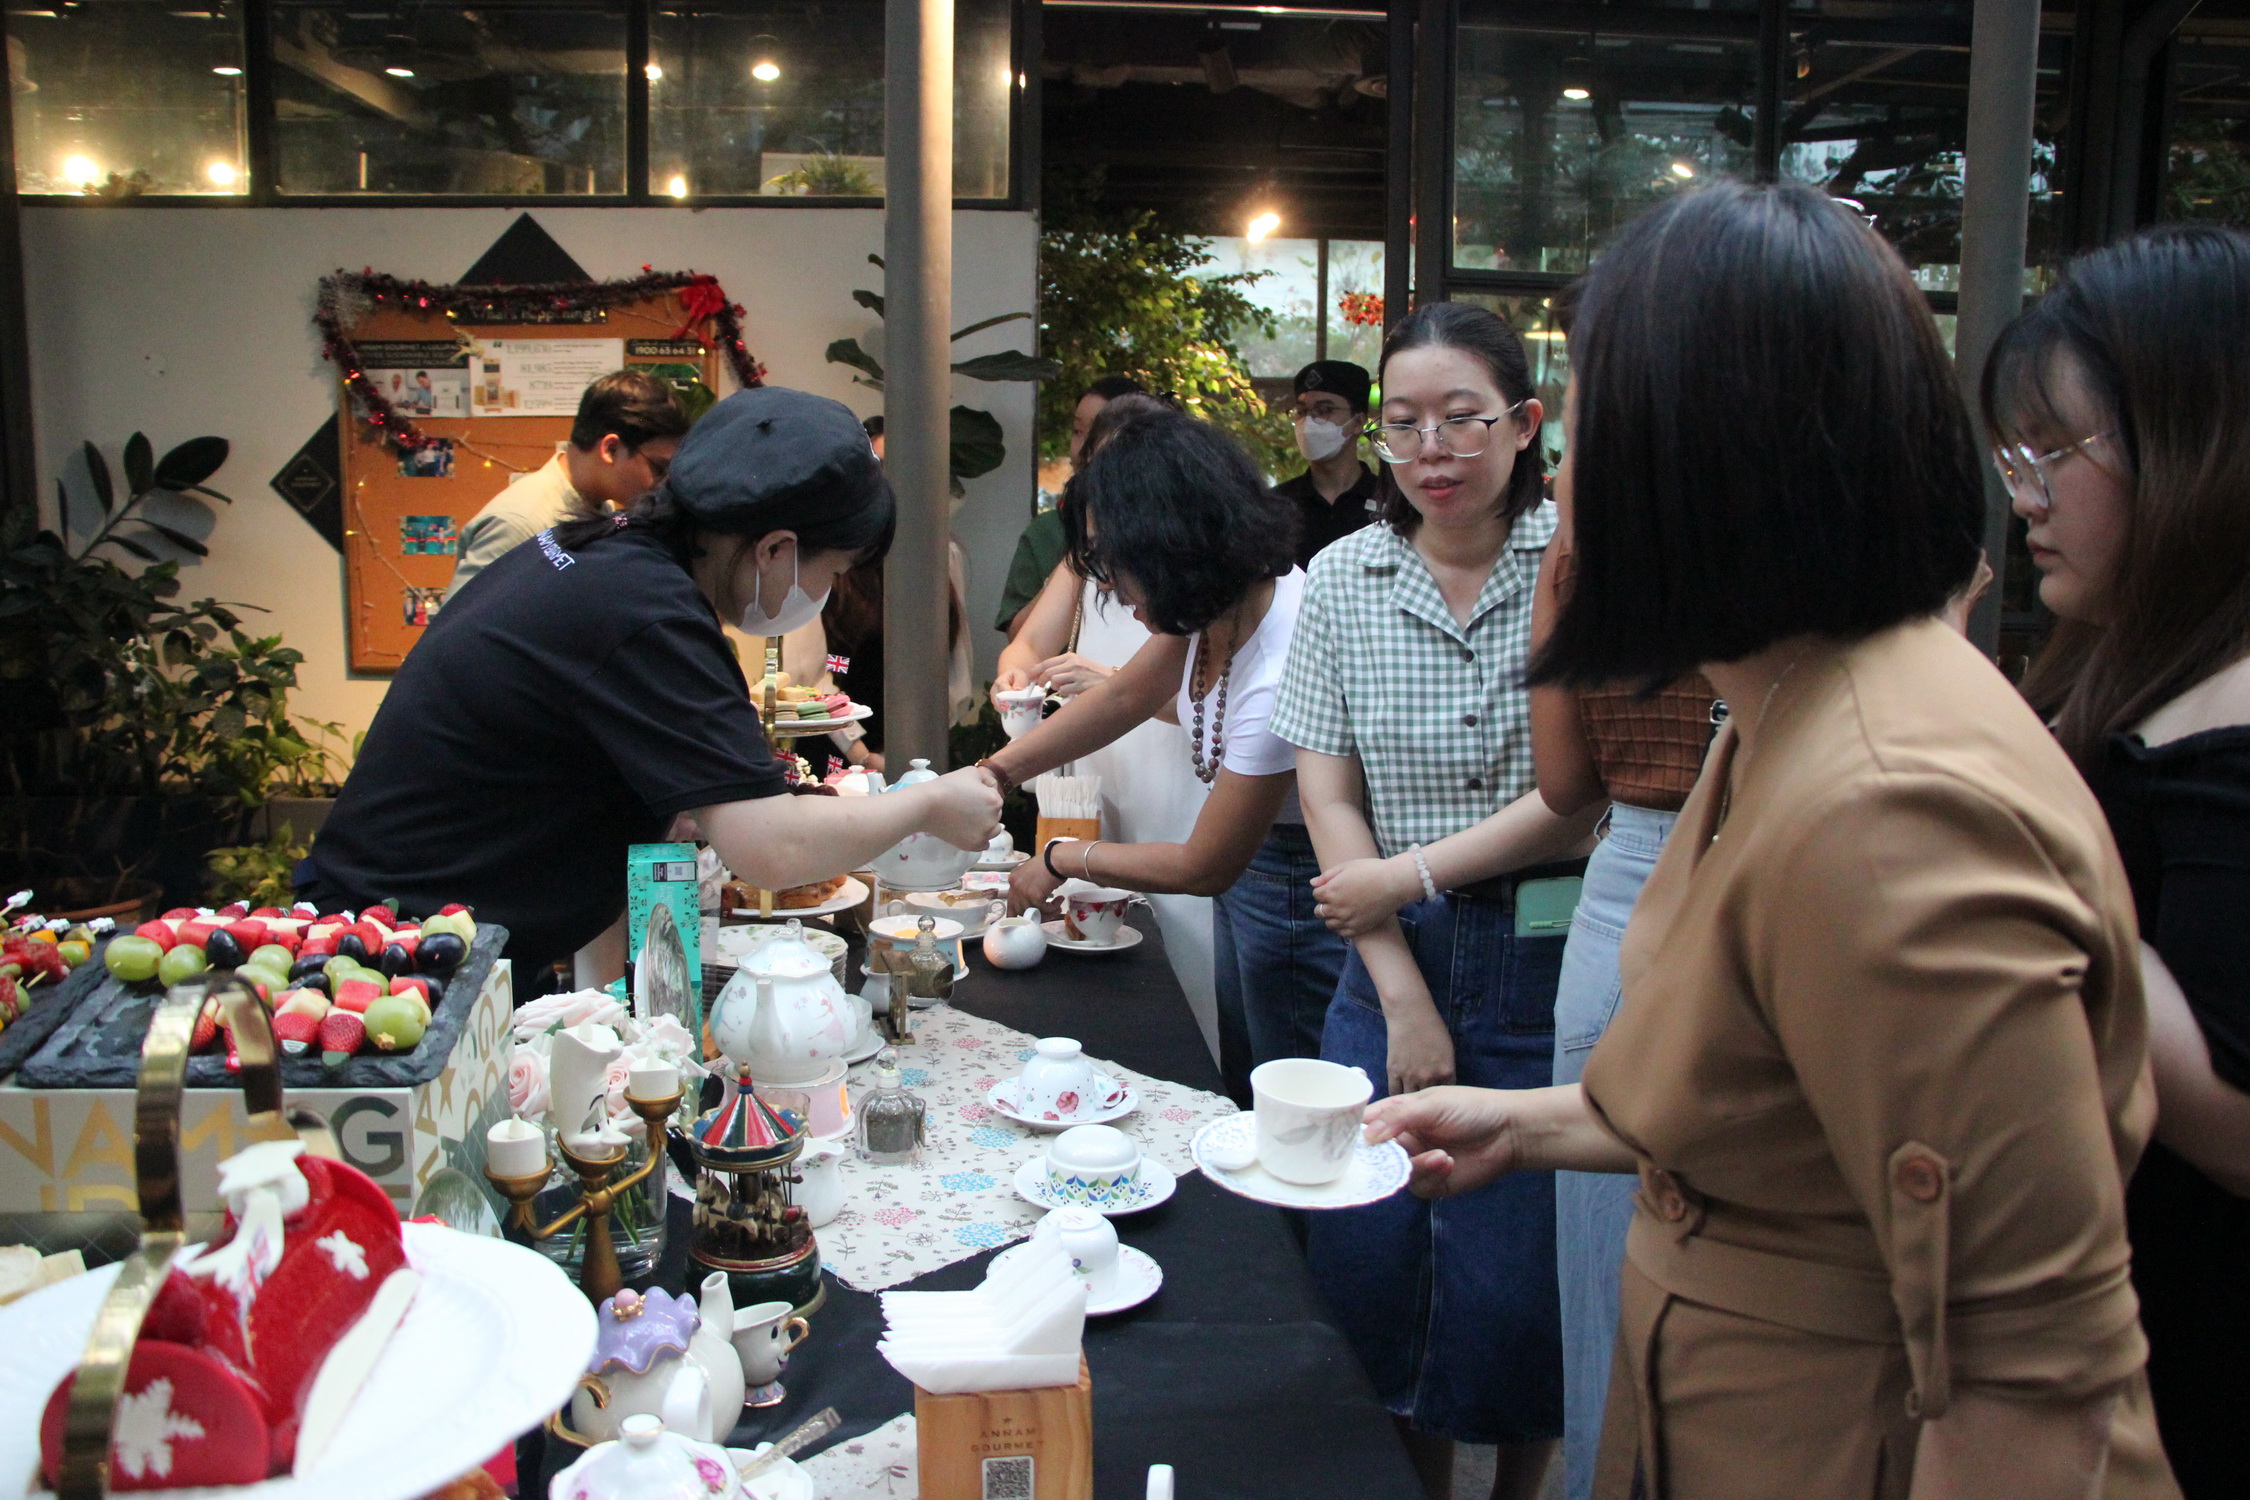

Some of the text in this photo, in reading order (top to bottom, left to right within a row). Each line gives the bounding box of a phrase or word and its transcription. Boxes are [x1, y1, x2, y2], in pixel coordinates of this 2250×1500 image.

[635, 346, 659, 355] 1900
[980, 1427, 1036, 1438] ANNAM
[971, 1440, 1044, 1452] GOURMET
